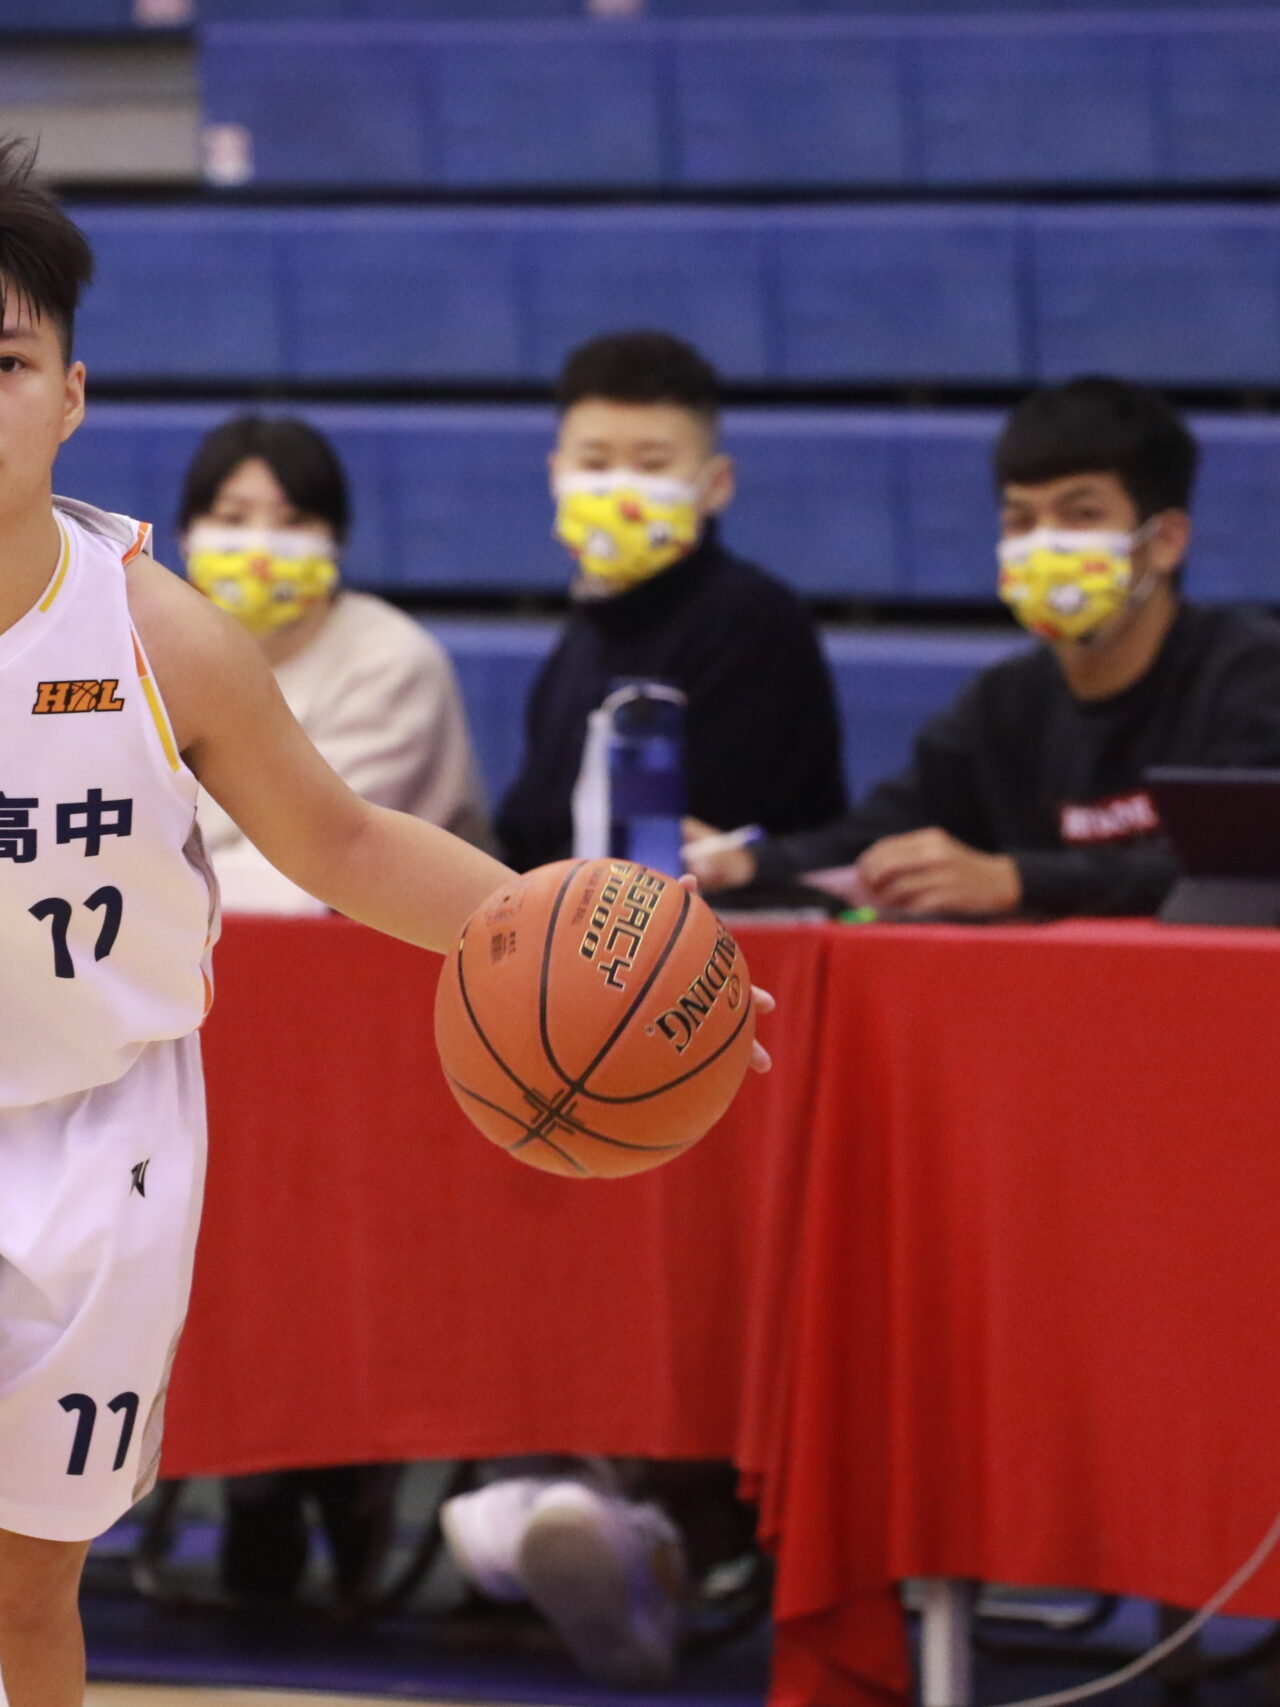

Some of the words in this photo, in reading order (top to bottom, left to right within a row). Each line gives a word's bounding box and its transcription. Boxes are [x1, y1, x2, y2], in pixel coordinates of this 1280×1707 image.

[31, 679, 125, 714] HBL
[28, 886, 123, 979] 11
[597, 868, 667, 992] EGACY
[58, 1391, 140, 1476] 11
